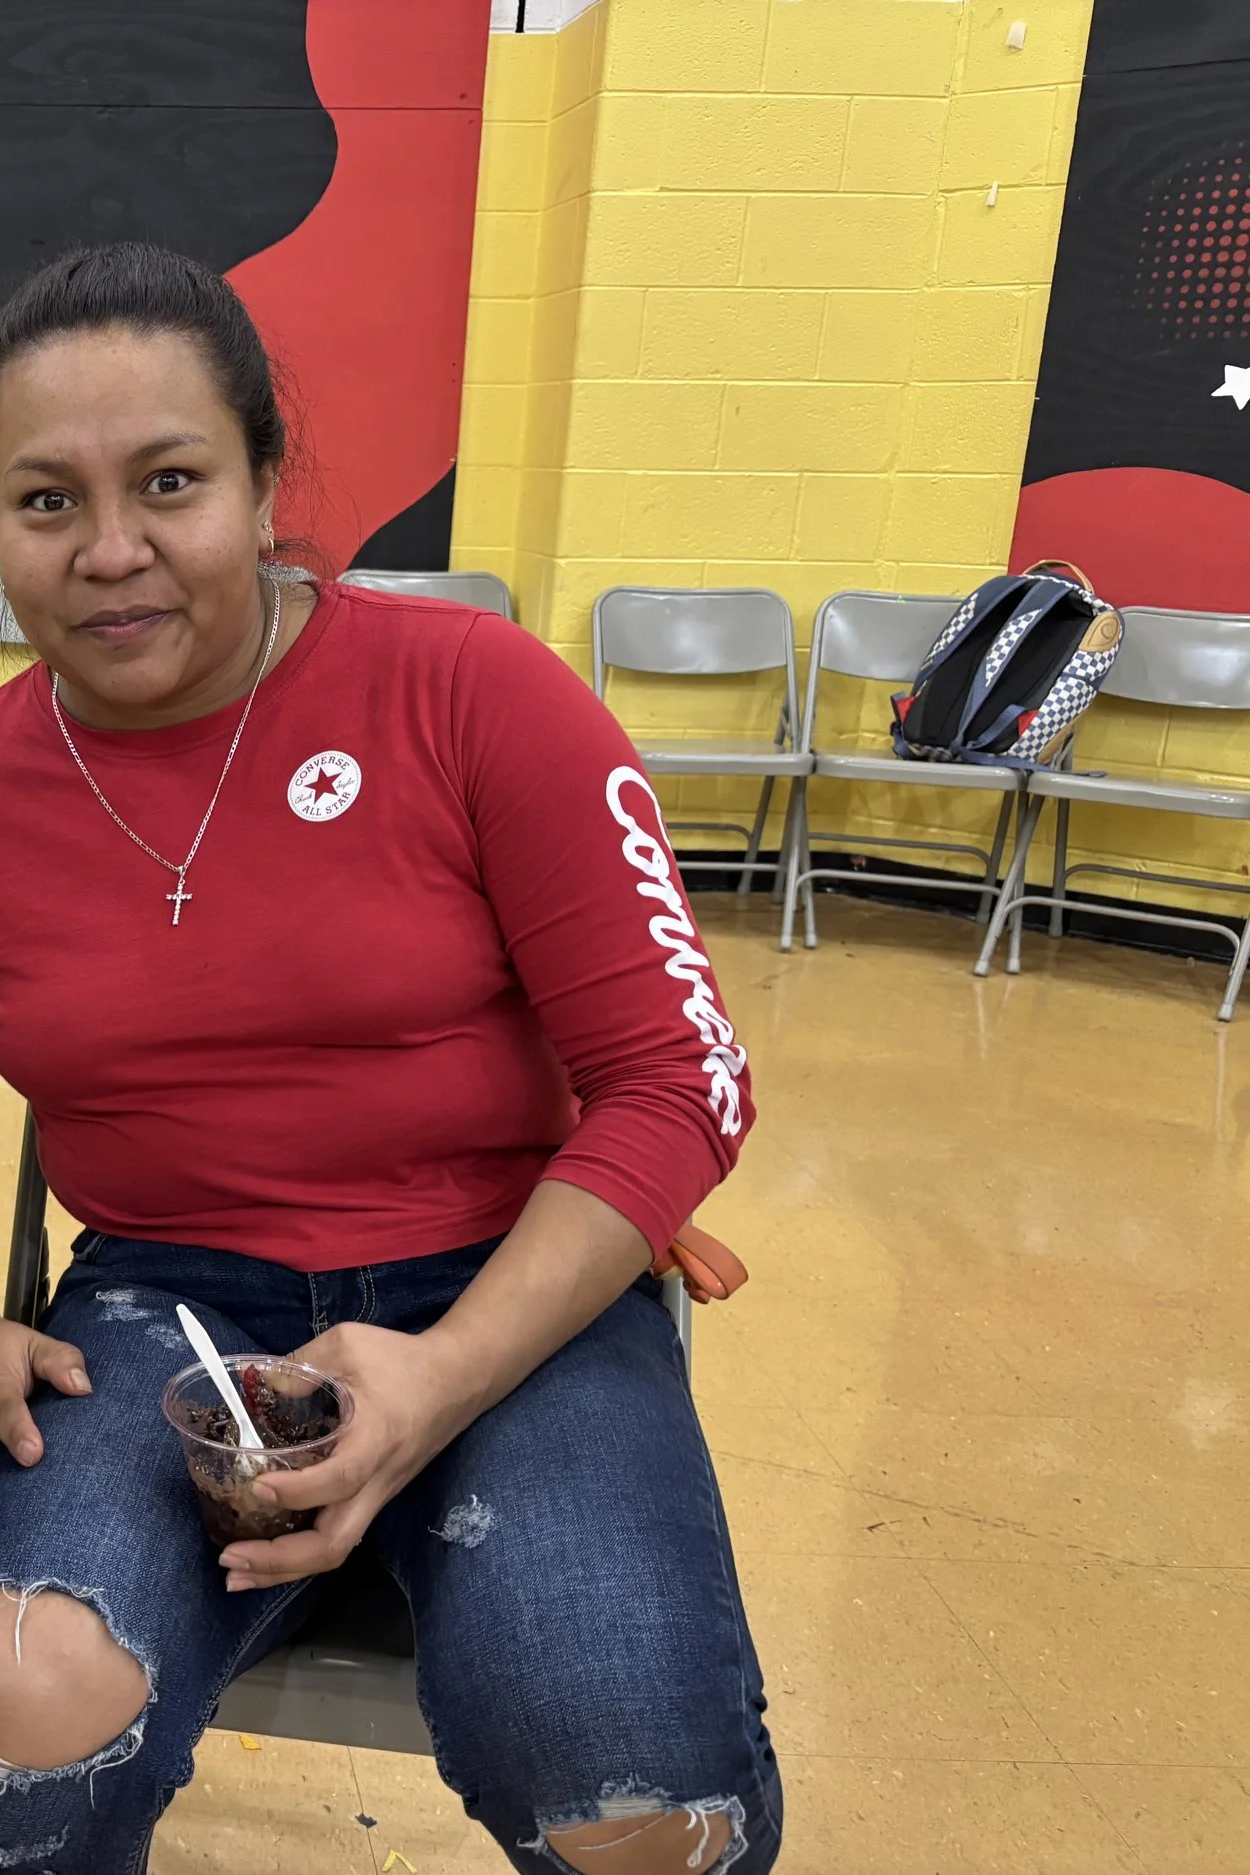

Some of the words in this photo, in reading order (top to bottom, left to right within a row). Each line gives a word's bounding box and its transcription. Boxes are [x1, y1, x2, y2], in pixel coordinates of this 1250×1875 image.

[295, 756, 350, 786] CONVERSE
[302, 805, 322, 816] ALL
[325, 791, 351, 815] STAR
